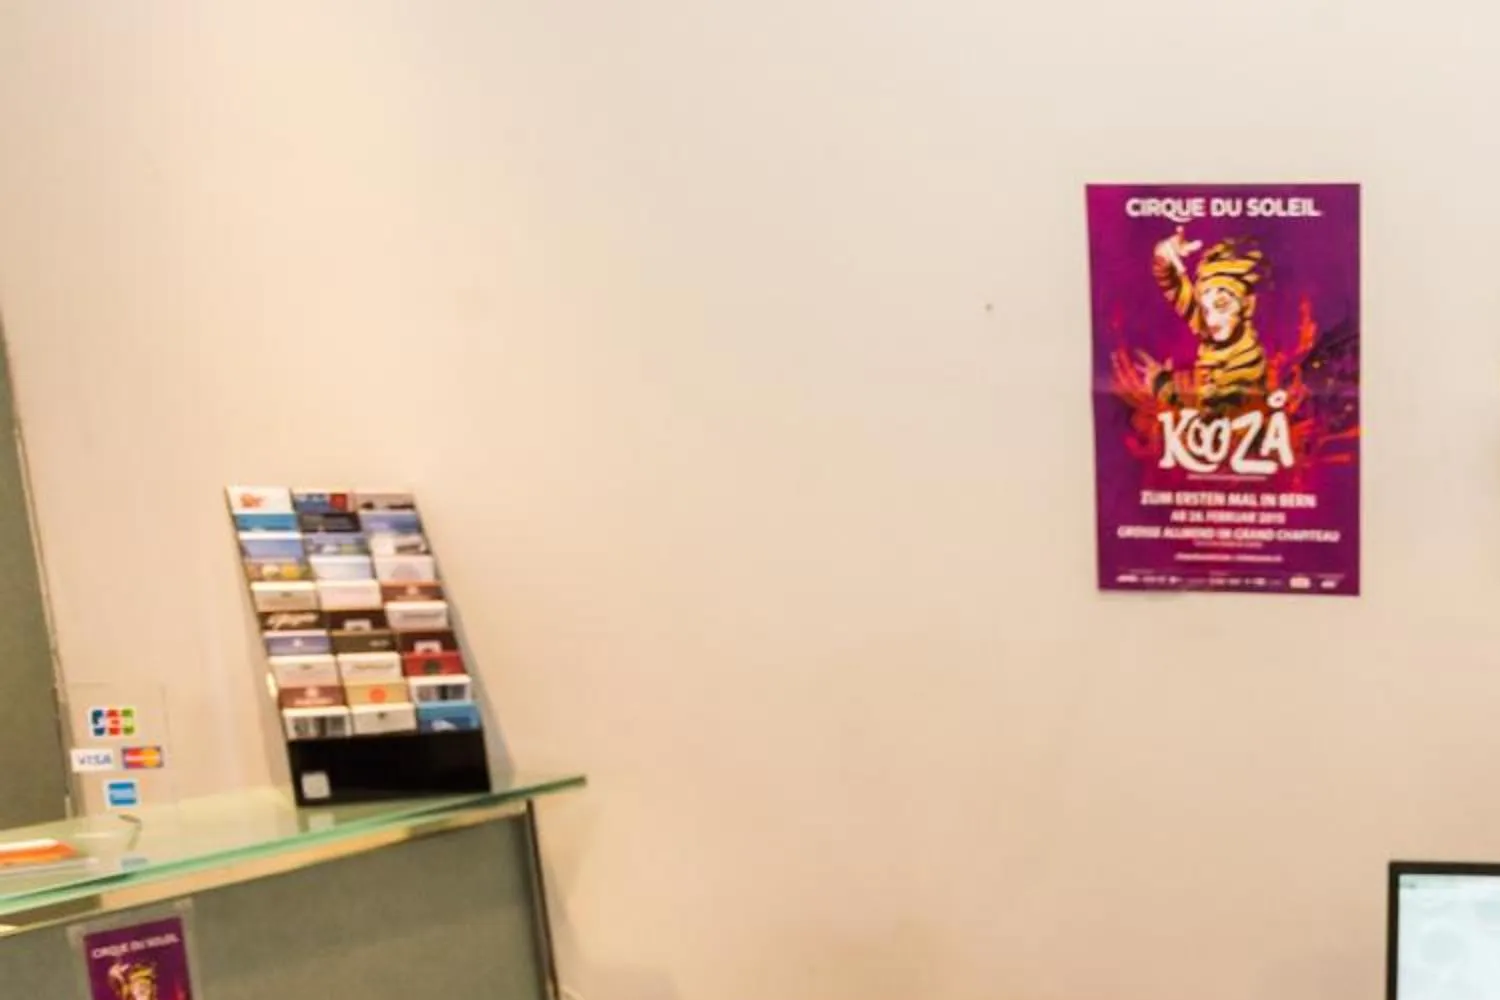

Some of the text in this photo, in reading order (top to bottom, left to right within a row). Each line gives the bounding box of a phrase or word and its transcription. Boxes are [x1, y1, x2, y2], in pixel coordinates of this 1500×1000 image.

[1125, 197, 1323, 223] CIRQUE DU SOLEIL
[1140, 490, 1317, 509] ZUM ERSTEN MAL IN BERN
